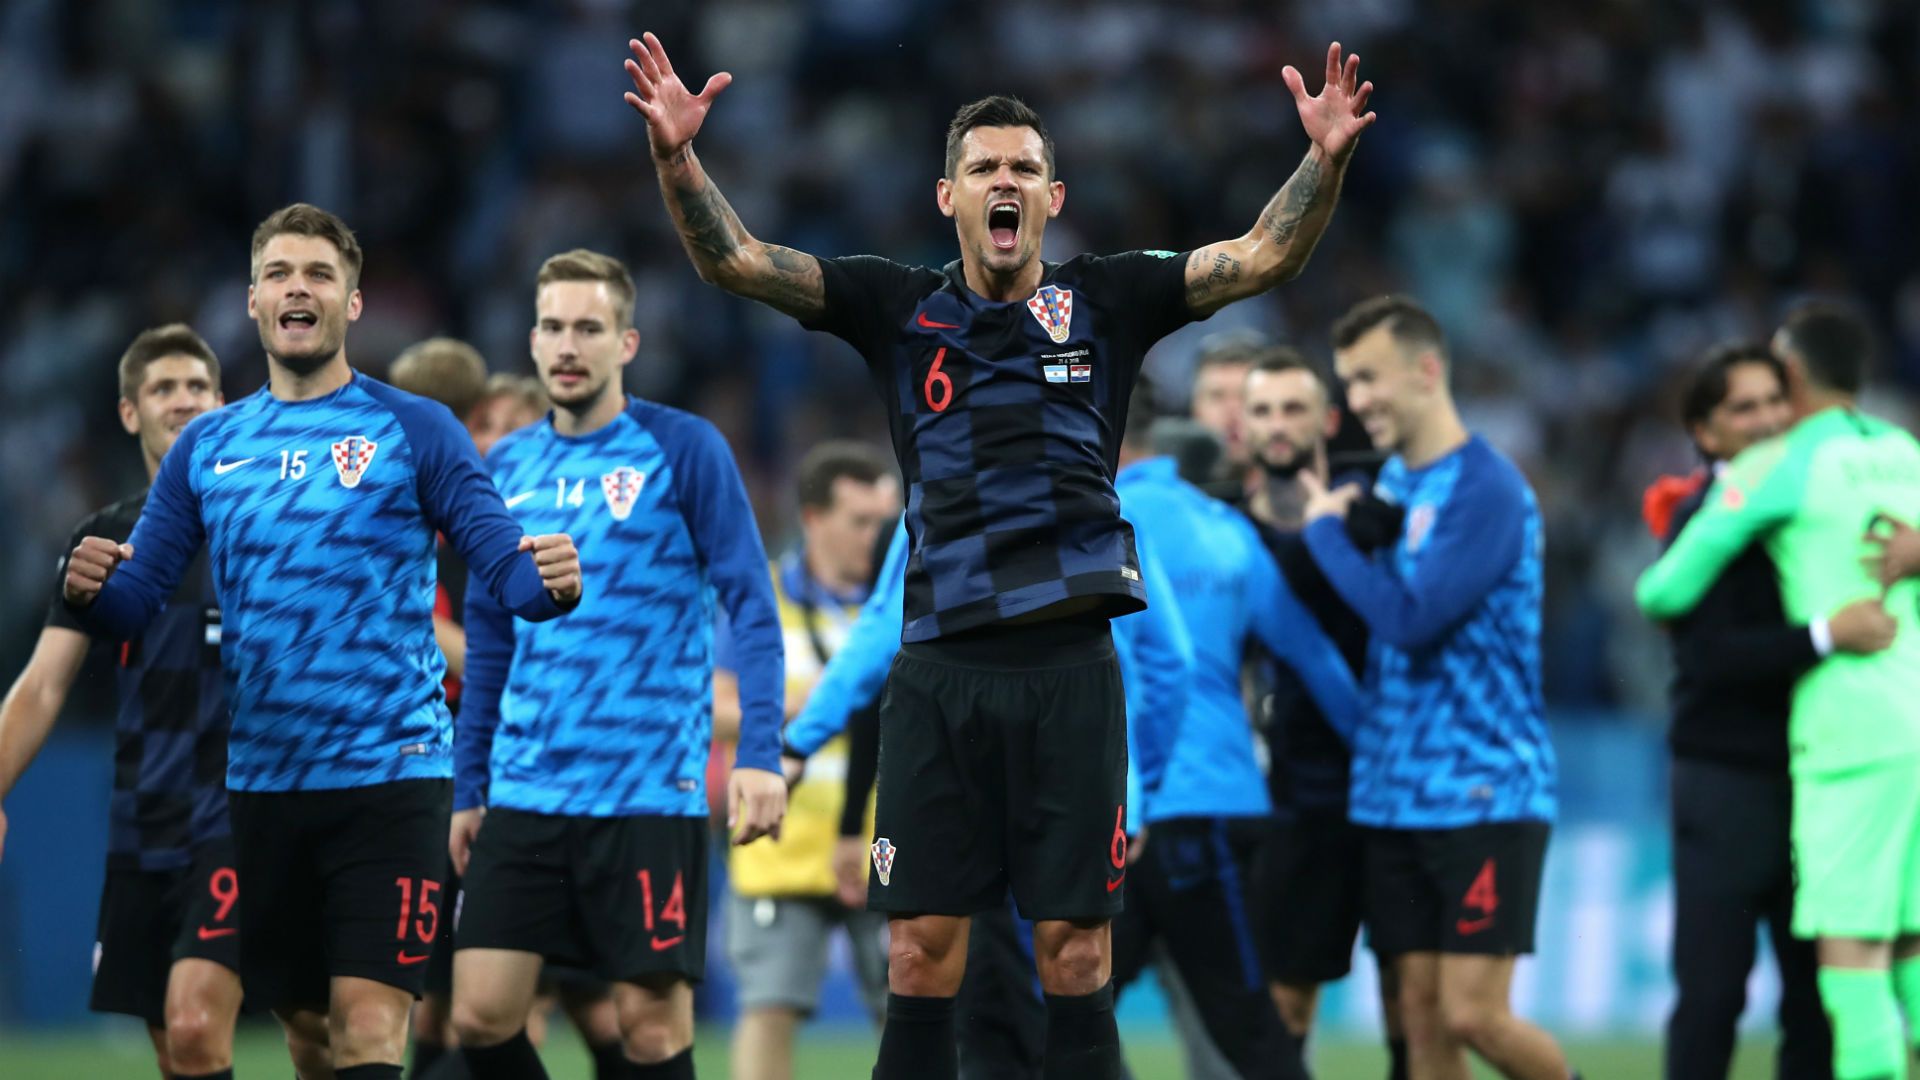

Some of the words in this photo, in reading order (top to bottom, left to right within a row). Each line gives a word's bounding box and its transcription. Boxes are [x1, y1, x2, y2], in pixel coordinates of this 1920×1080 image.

[1208, 252, 1232, 285] Josip
[924, 347, 953, 412] 6
[279, 449, 308, 481] 15
[555, 477, 585, 508] 14
[1110, 804, 1126, 869] 6
[209, 867, 239, 921] 9
[396, 877, 441, 944] 15
[637, 869, 686, 930] 14
[1463, 857, 1498, 913] 4
